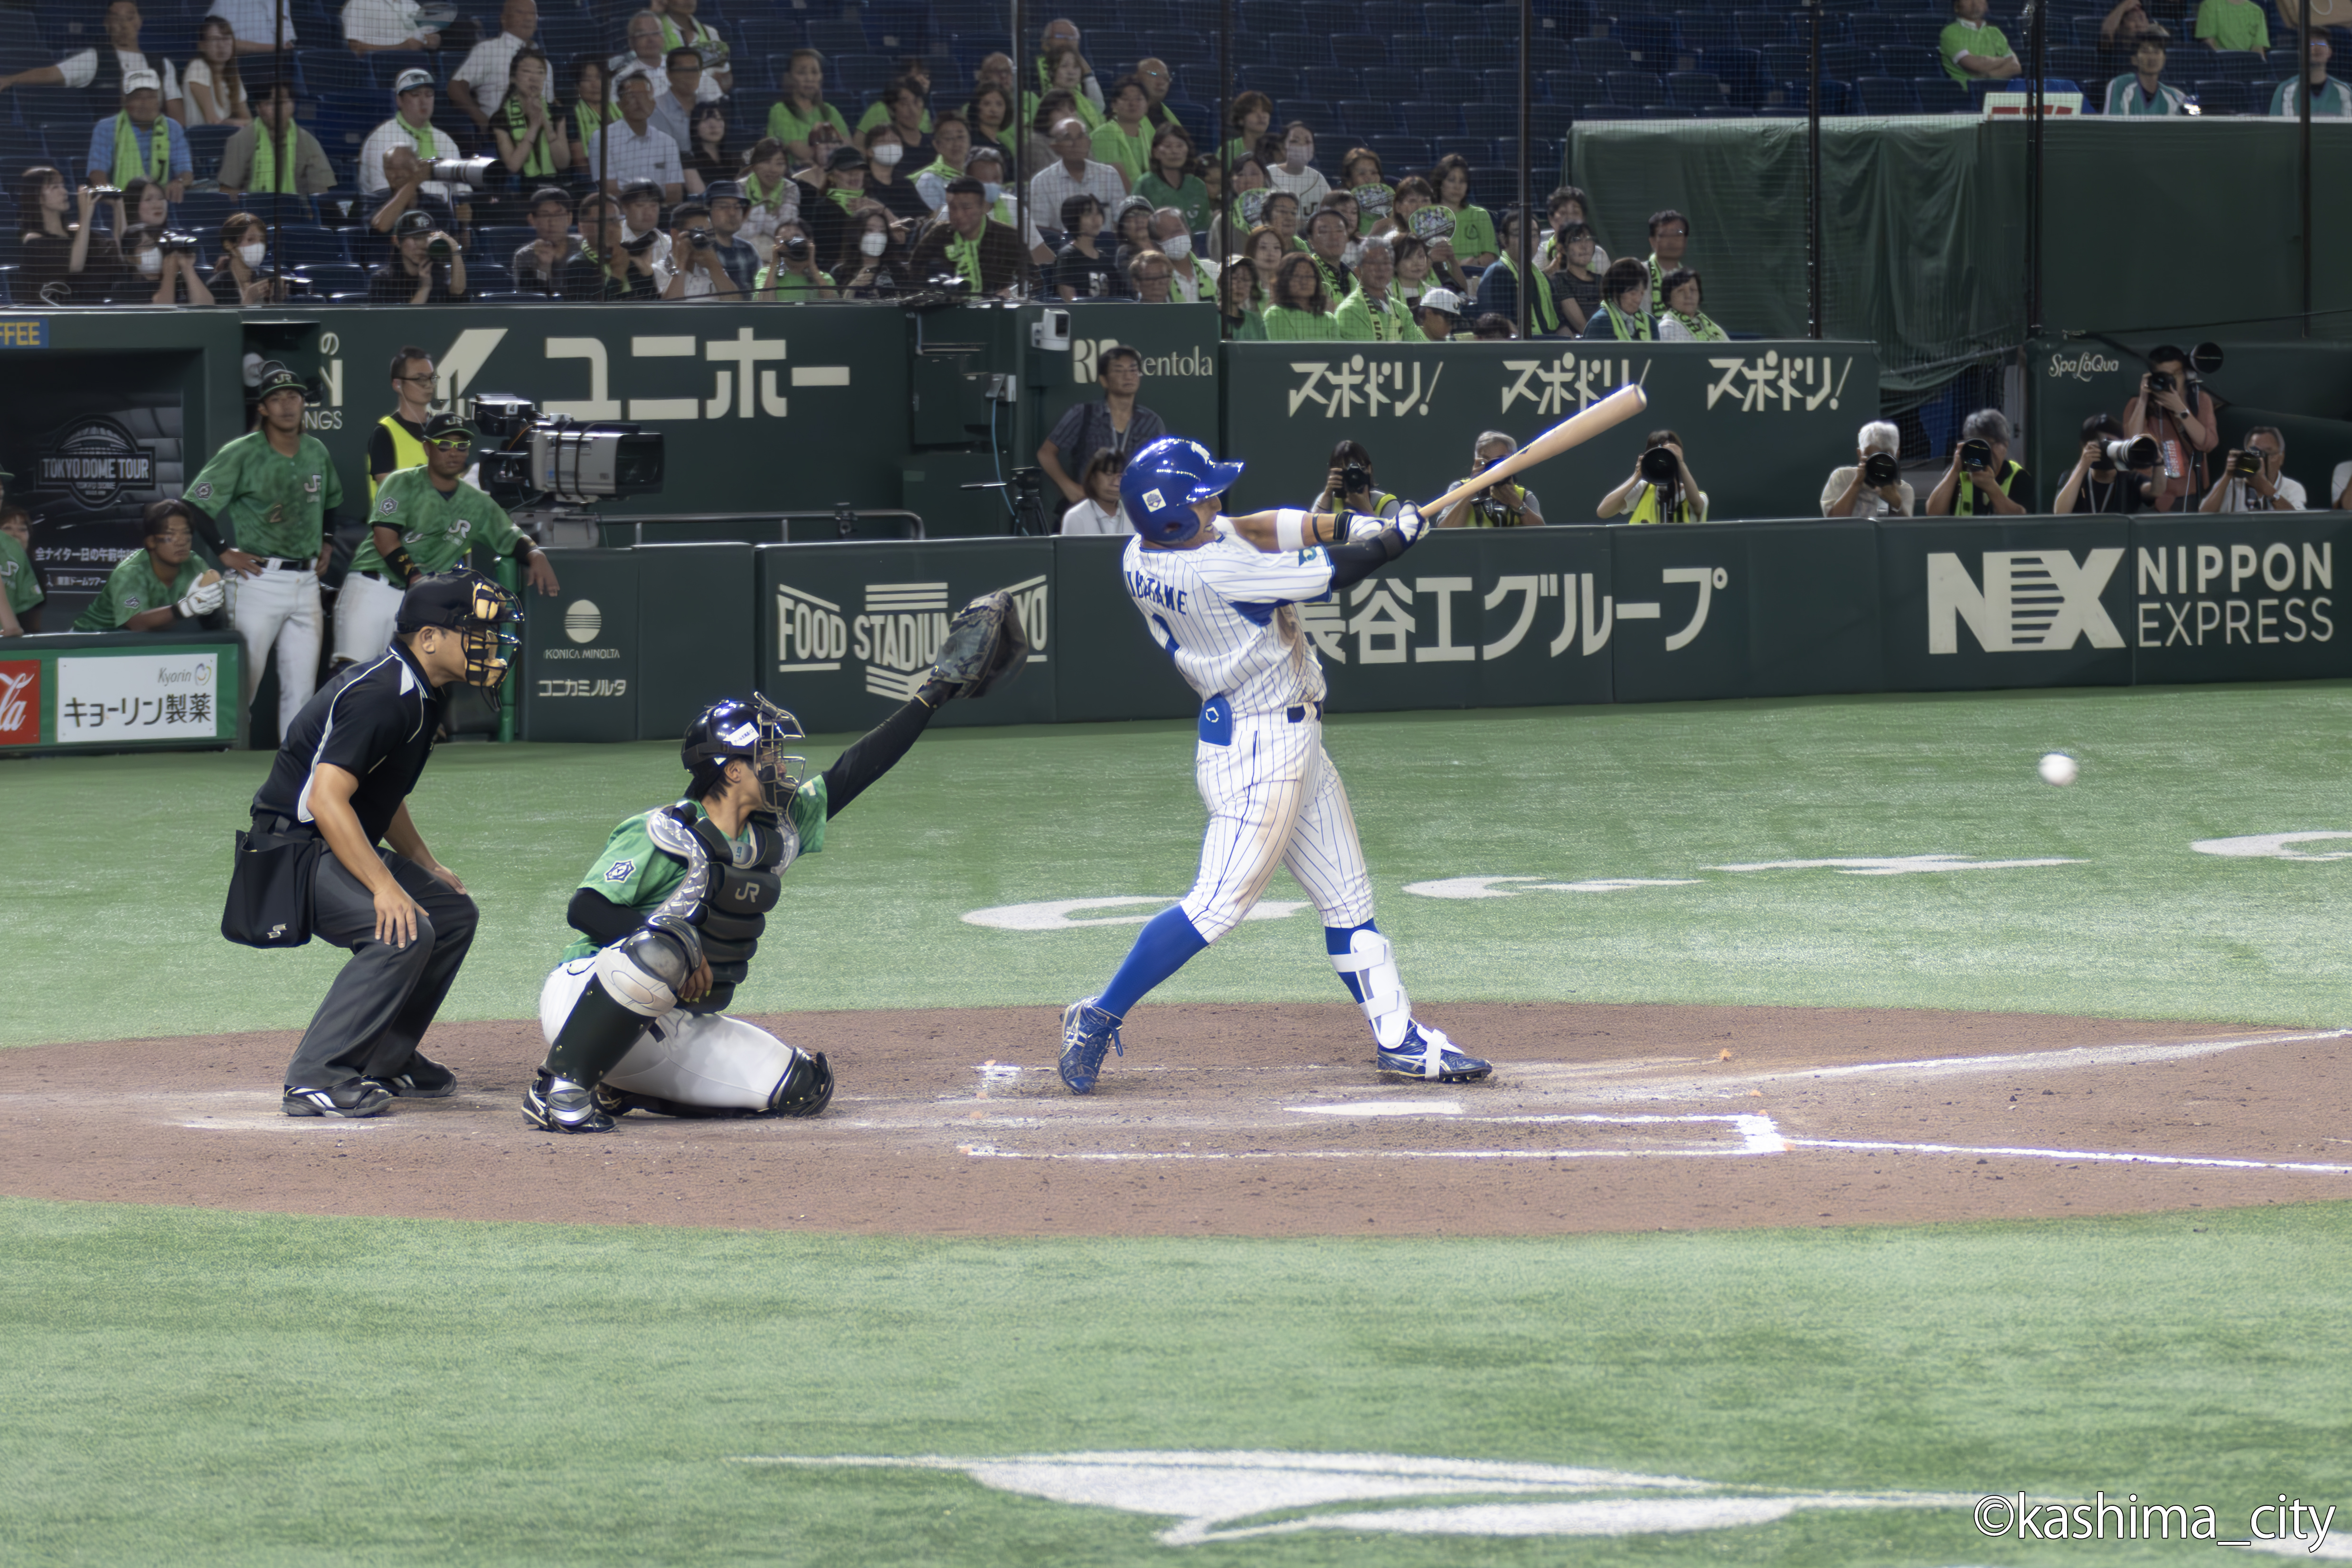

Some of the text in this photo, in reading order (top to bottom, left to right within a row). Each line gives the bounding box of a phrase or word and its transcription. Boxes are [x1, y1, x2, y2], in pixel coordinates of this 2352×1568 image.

[541, 327, 850, 422] ユニホー
[1138, 345, 1213, 376] entola
[1288, 353, 1444, 418] スポドリ!
[1707, 349, 1853, 412] スポドリ!
[43, 458, 149, 479] TOKYO DOME TOUR
[2138, 542, 2333, 595] NIPPON
[777, 594, 847, 661] FOOD
[2138, 596, 2333, 648] EXPRESS
[545, 649, 621, 660] KONICA MINOLTA
[158, 667, 191, 687] Kyorin
[537, 679, 627, 697] コニカミノルタ
[64, 693, 212, 728] キョーリン製薬
[735, 881, 760, 903] JR
